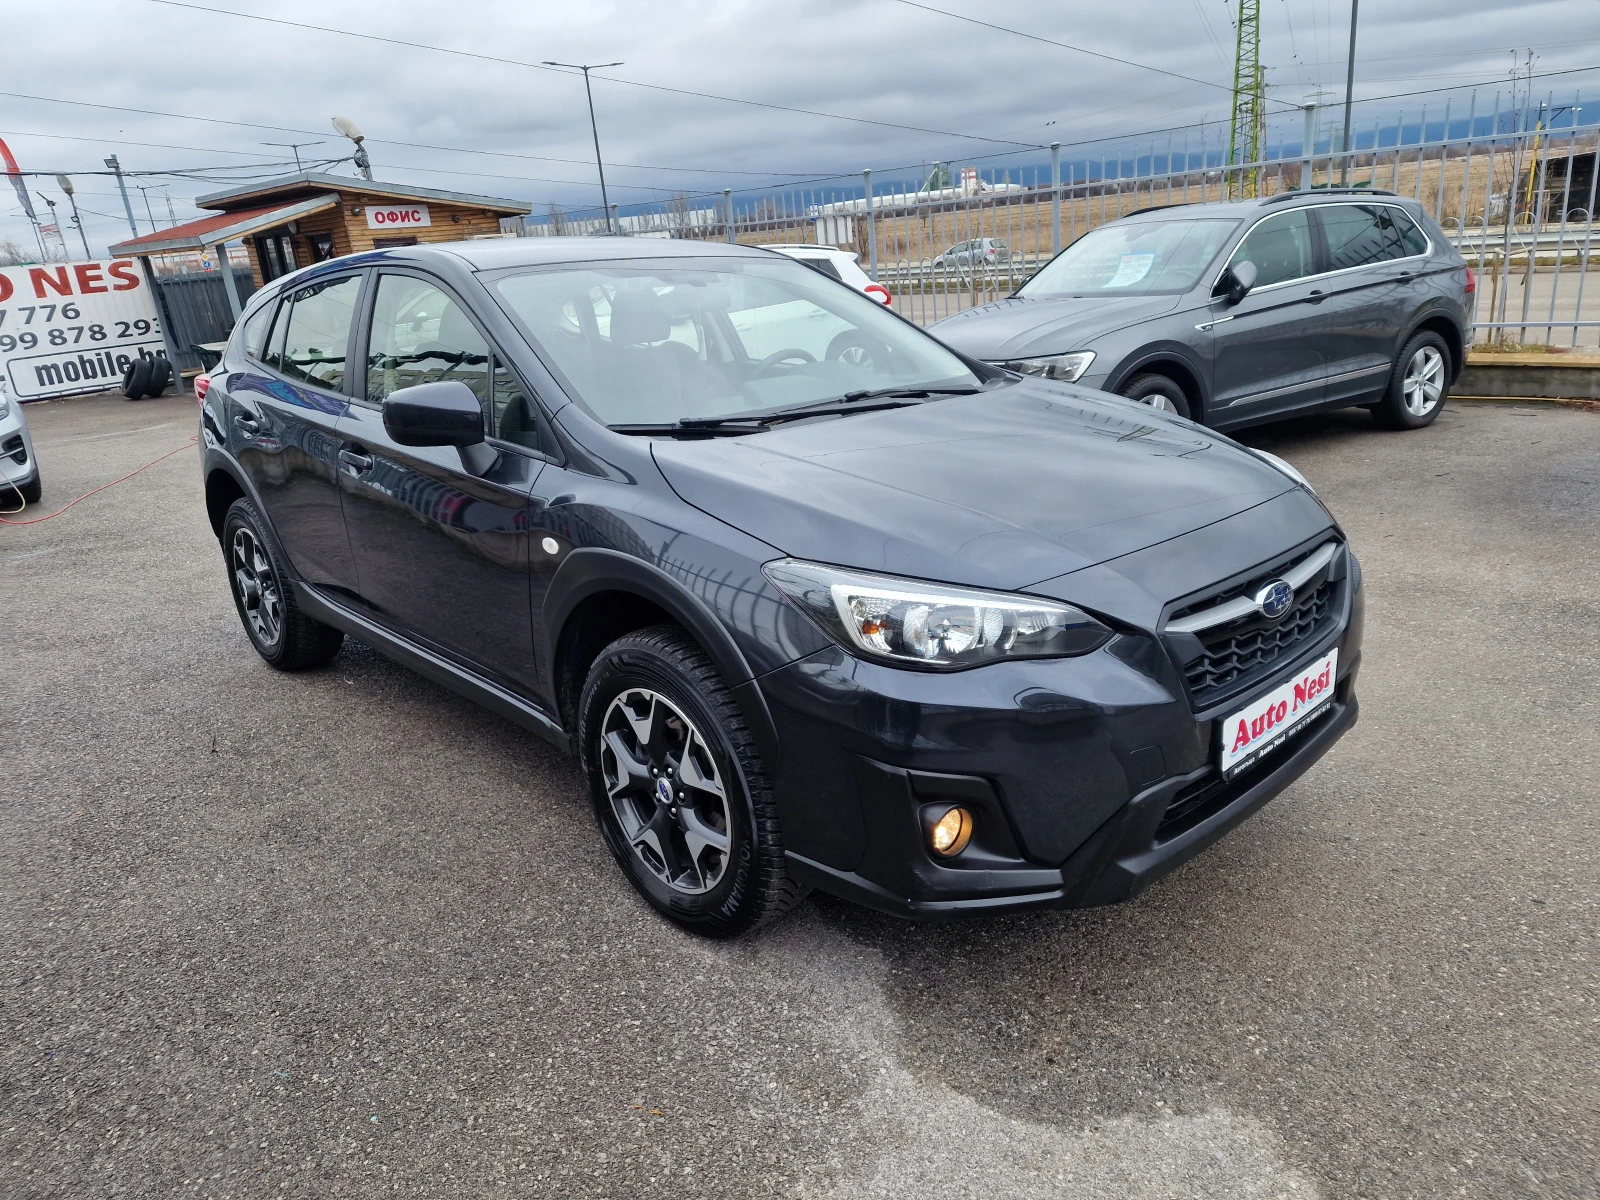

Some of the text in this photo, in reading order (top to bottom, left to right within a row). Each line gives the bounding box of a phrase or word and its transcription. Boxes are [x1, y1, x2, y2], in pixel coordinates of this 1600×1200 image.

[374, 209, 422, 224] ОФИС
[28, 260, 140, 299] NES
[17, 302, 81, 325] 776
[47, 324, 108, 347] 878
[1231, 700, 1288, 753] Auto
[1292, 661, 1331, 713] Nesi
[721, 840, 751, 917] YOKOHAMA
